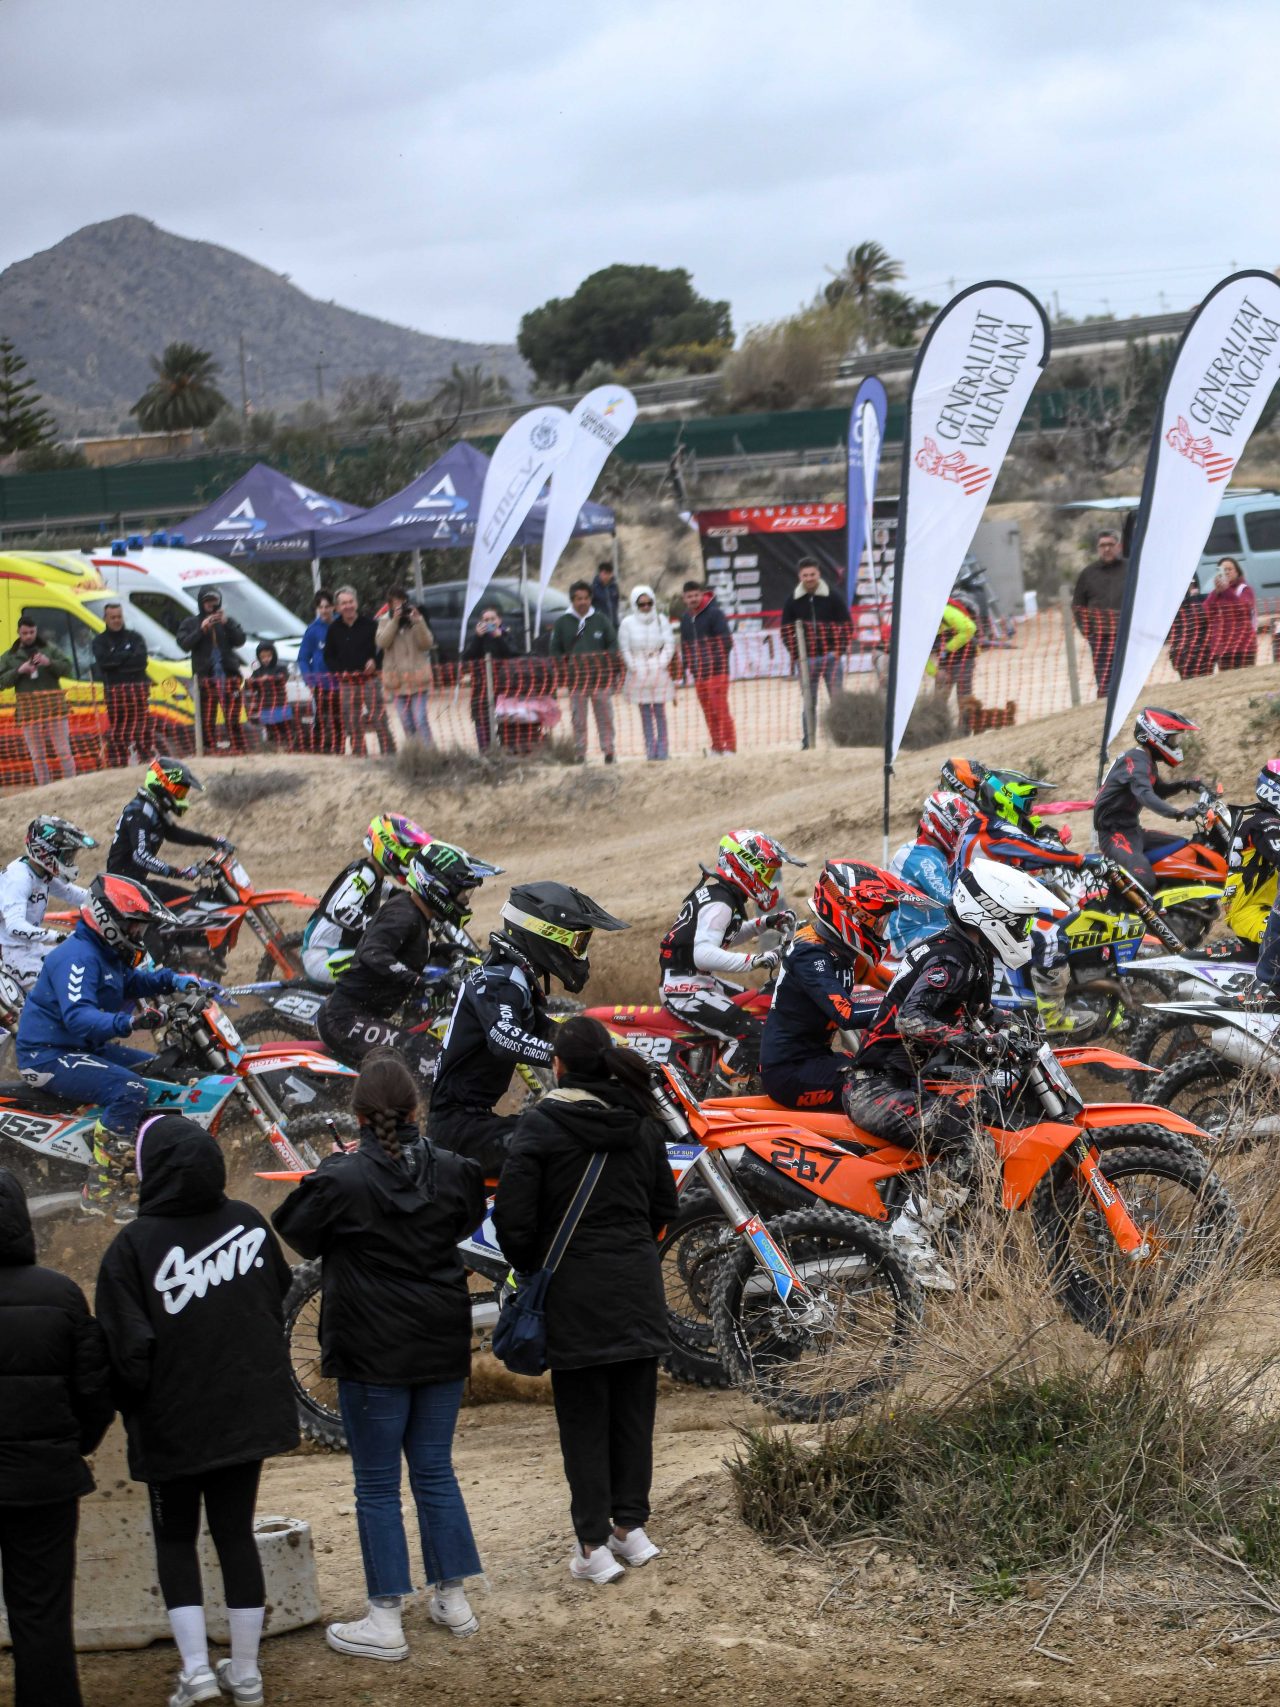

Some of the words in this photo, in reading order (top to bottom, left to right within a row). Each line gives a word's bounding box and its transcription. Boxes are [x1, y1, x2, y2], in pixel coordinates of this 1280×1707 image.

[1189, 295, 1263, 424] GENERALITAT
[936, 309, 1004, 440] GENERALITAT
[961, 323, 1032, 446] VALENCIANA
[771, 516, 834, 528] FMCV
[942, 767, 969, 793] SCOTT
[738, 849, 767, 875] 100%
[836, 896, 874, 924] OAKLEY
[974, 891, 1021, 927] 100%
[347, 1022, 400, 1047] FOX
[248, 1058, 281, 1069] MOTUL
[796, 1090, 834, 1107] KTM
[0, 1112, 53, 1144] 152
[274, 1141, 302, 1173] MOTUL
